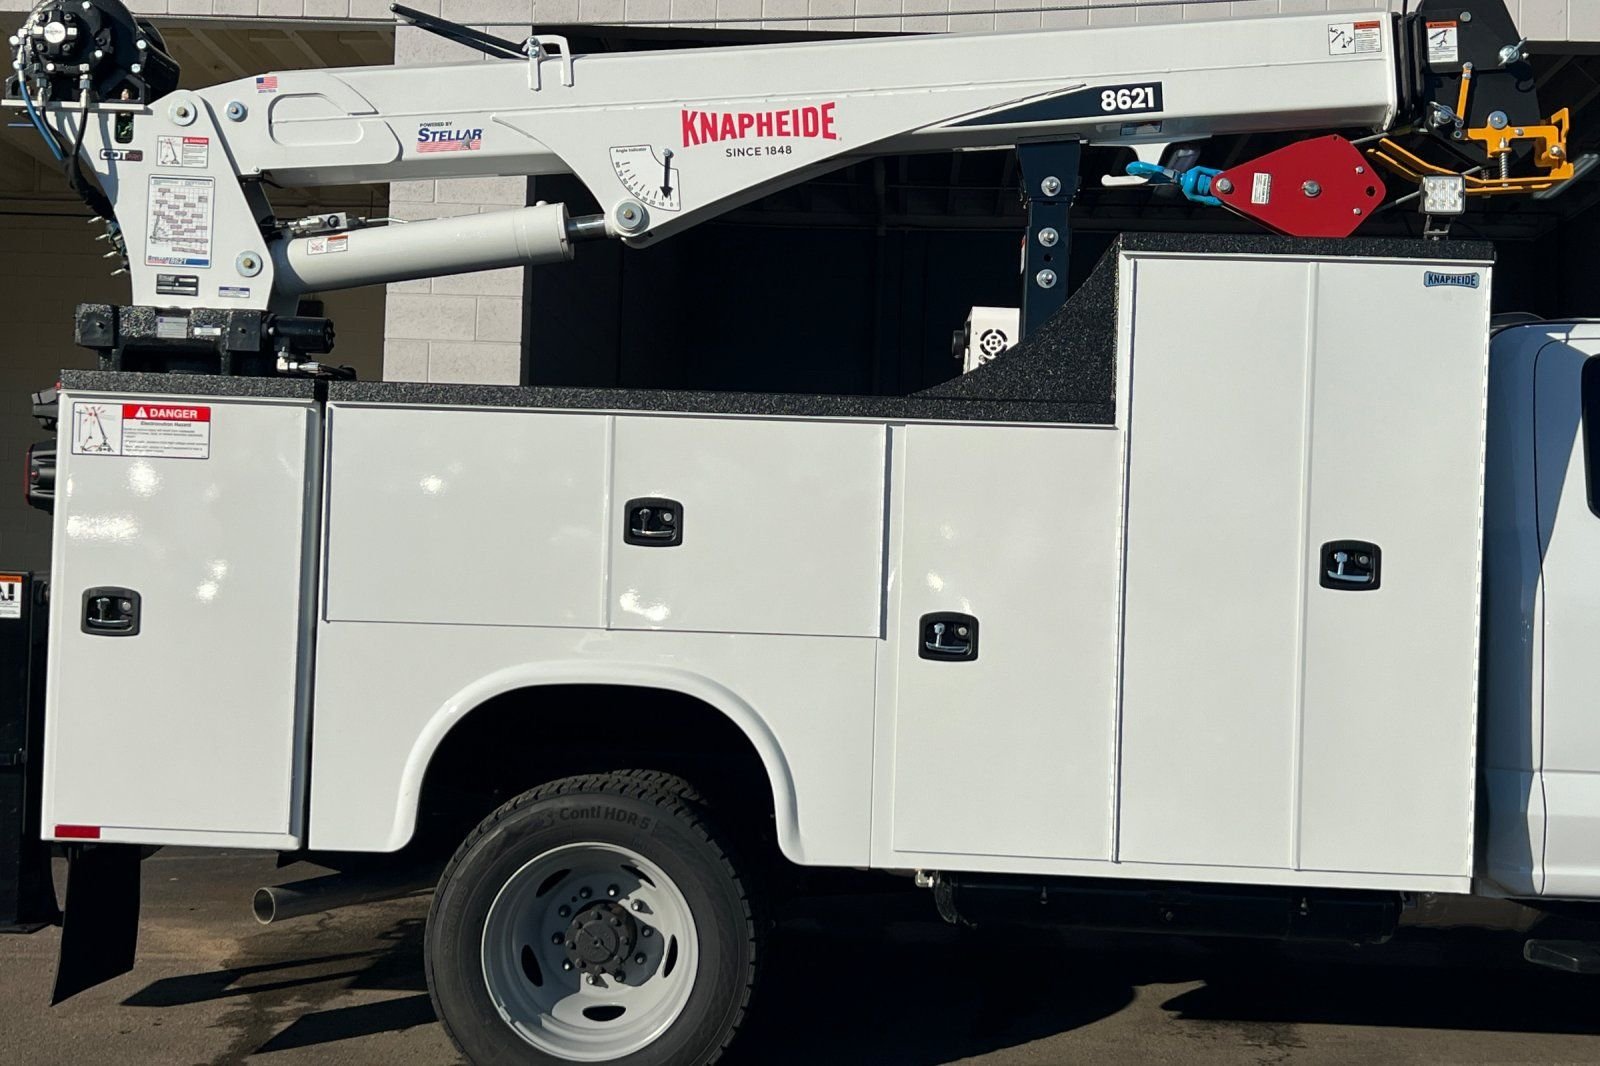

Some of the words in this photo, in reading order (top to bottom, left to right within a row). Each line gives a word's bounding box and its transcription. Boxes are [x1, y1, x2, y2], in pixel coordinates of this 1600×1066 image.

[1101, 86, 1155, 111] 8621
[681, 102, 837, 148] KNAPHEIDE
[417, 128, 482, 142] STELLAR
[726, 147, 762, 157] SINCE
[766, 145, 792, 155] 1848
[1428, 273, 1476, 286] KNAPHEIDE
[149, 408, 198, 419] DANGER
[560, 806, 601, 820] Conti
[604, 806, 638, 826] HDR
[639, 816, 651, 830] 5
